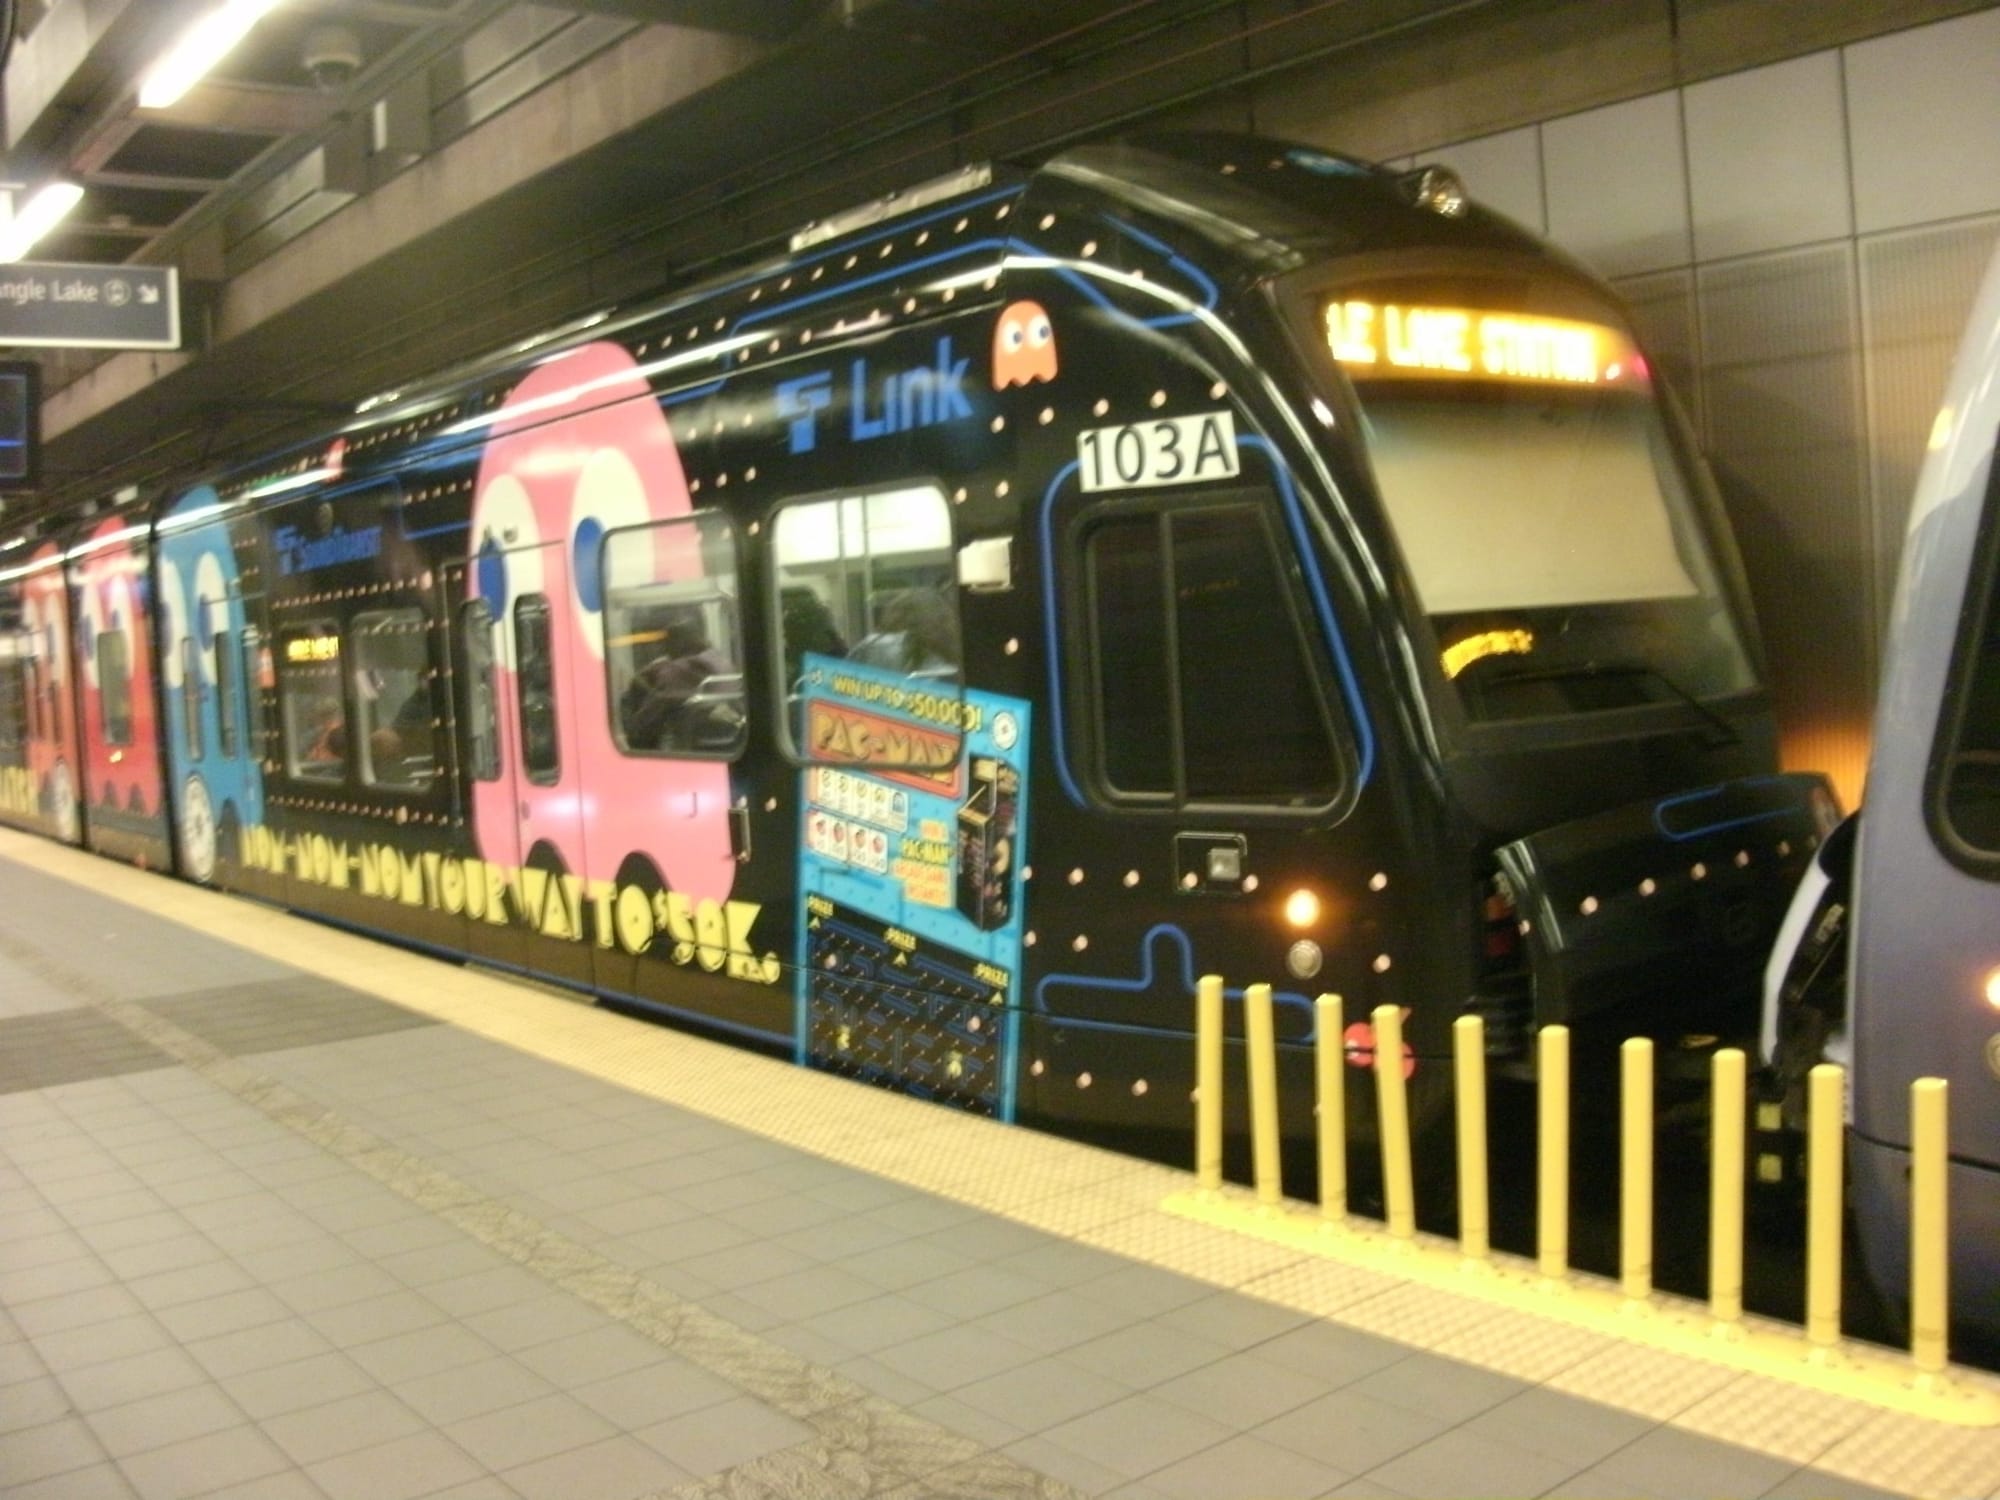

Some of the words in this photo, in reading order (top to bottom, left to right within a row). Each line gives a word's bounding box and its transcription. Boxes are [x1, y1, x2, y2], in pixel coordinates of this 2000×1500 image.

[53, 279, 99, 303] Lake
[850, 336, 974, 443] Link
[1084, 415, 1234, 487] 103A
[423, 851, 509, 926] YOUR
[509, 866, 584, 941] WAY
[586, 878, 654, 955] TO
